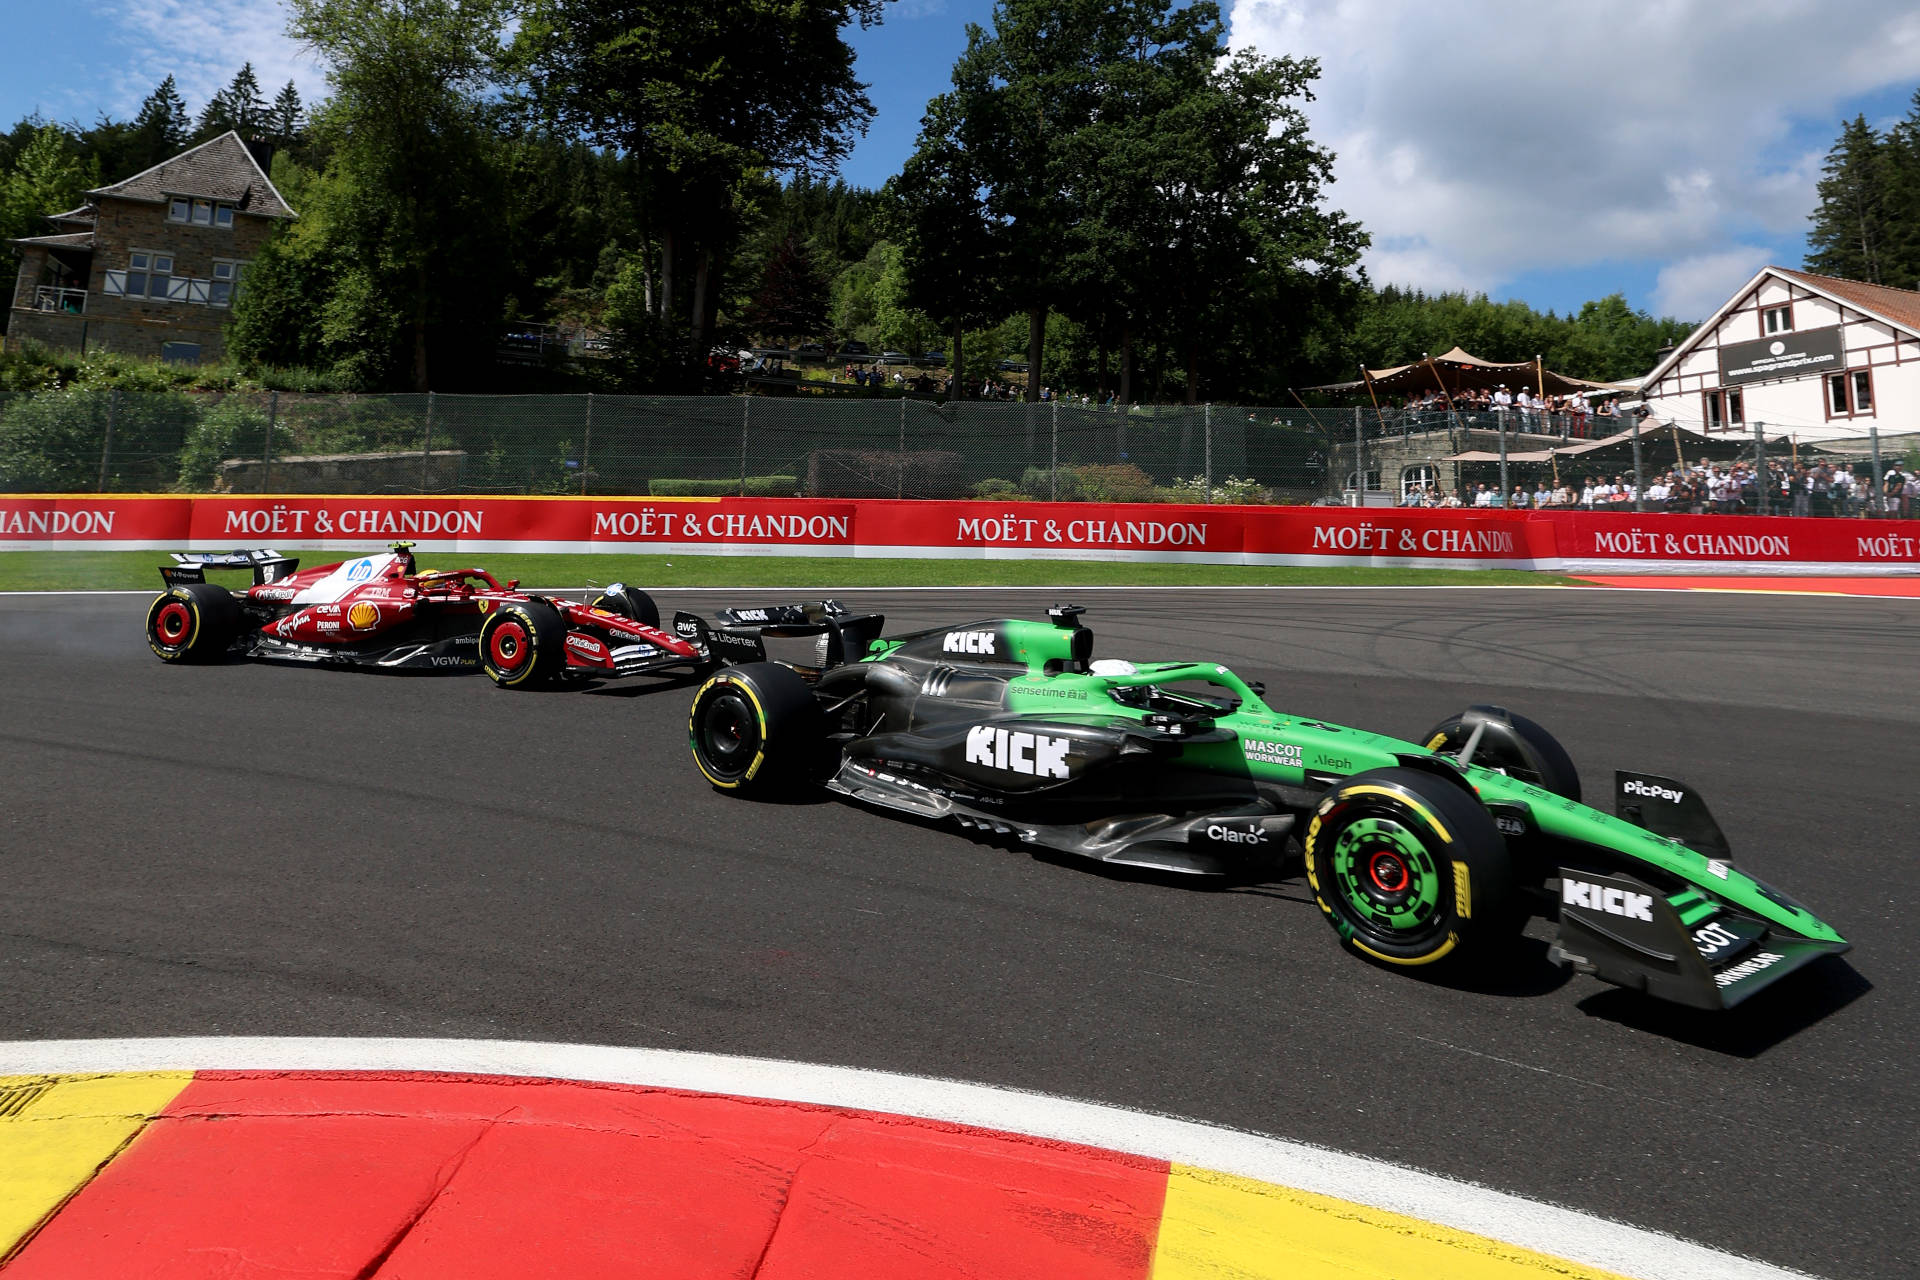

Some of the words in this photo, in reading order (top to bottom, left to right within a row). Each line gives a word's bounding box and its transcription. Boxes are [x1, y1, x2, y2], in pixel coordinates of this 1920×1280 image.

[223, 504, 309, 534] MOËT
[315, 510, 334, 534] &
[338, 510, 484, 535] CHANDON
[593, 507, 677, 537] MOËT
[682, 512, 702, 537] &
[706, 513, 849, 539] CHANDON
[956, 513, 1039, 542] MOËT
[1043, 518, 1063, 543] &
[1067, 519, 1207, 546] CHANDON
[1312, 522, 1394, 551] MOËT
[1397, 528, 1417, 551] &
[1422, 529, 1514, 553] CHANDON
[1595, 528, 1660, 554] MOËT
[1665, 533, 1682, 555] &
[1683, 533, 1791, 556] CHANDON
[1856, 532, 1915, 557] MOËT
[736, 609, 769, 621] KICK
[1048, 608, 1063, 616] HUL
[316, 620, 340, 629] PERONI
[677, 622, 697, 632] aws
[718, 632, 757, 648] Libertex
[942, 631, 996, 655] KICK
[431, 656, 460, 666] VGW
[1011, 685, 1066, 699] sensetime
[965, 725, 1070, 780] KICK
[1244, 739, 1304, 759] MASCOT
[1244, 751, 1304, 769] WORKWEAR
[1314, 753, 1353, 770] Aleph
[1623, 780, 1684, 804] PicPay
[1207, 824, 1265, 846] Claro
[1562, 877, 1653, 922] KICK
[1691, 921, 1740, 957] COT
